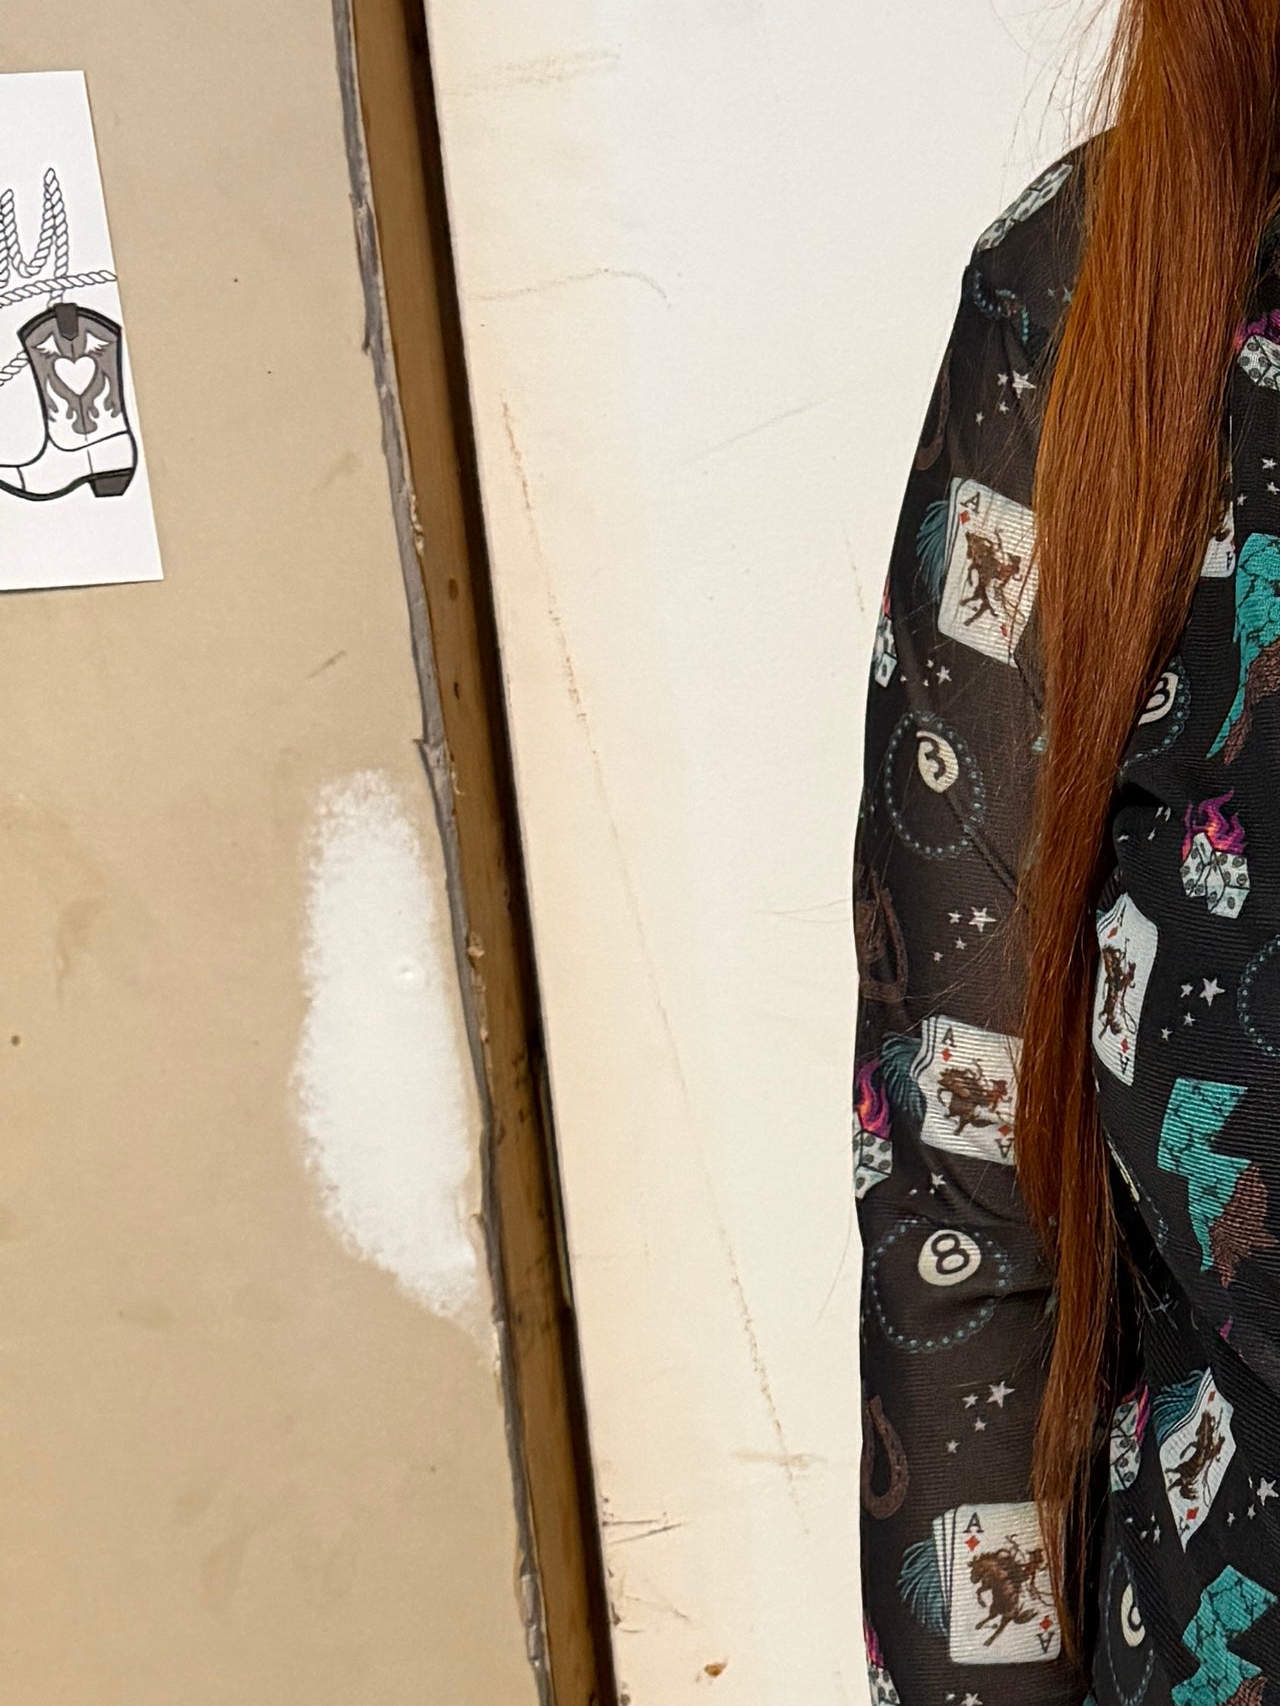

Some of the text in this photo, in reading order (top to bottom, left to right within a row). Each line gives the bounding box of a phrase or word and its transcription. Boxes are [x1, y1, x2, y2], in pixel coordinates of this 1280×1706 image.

[961, 492, 981, 513] A
[942, 1026, 957, 1047] A
[995, 1137, 1015, 1158] A
[931, 1234, 968, 1274] 8
[963, 1513, 984, 1533] A
[1037, 1632, 1055, 1654] A
